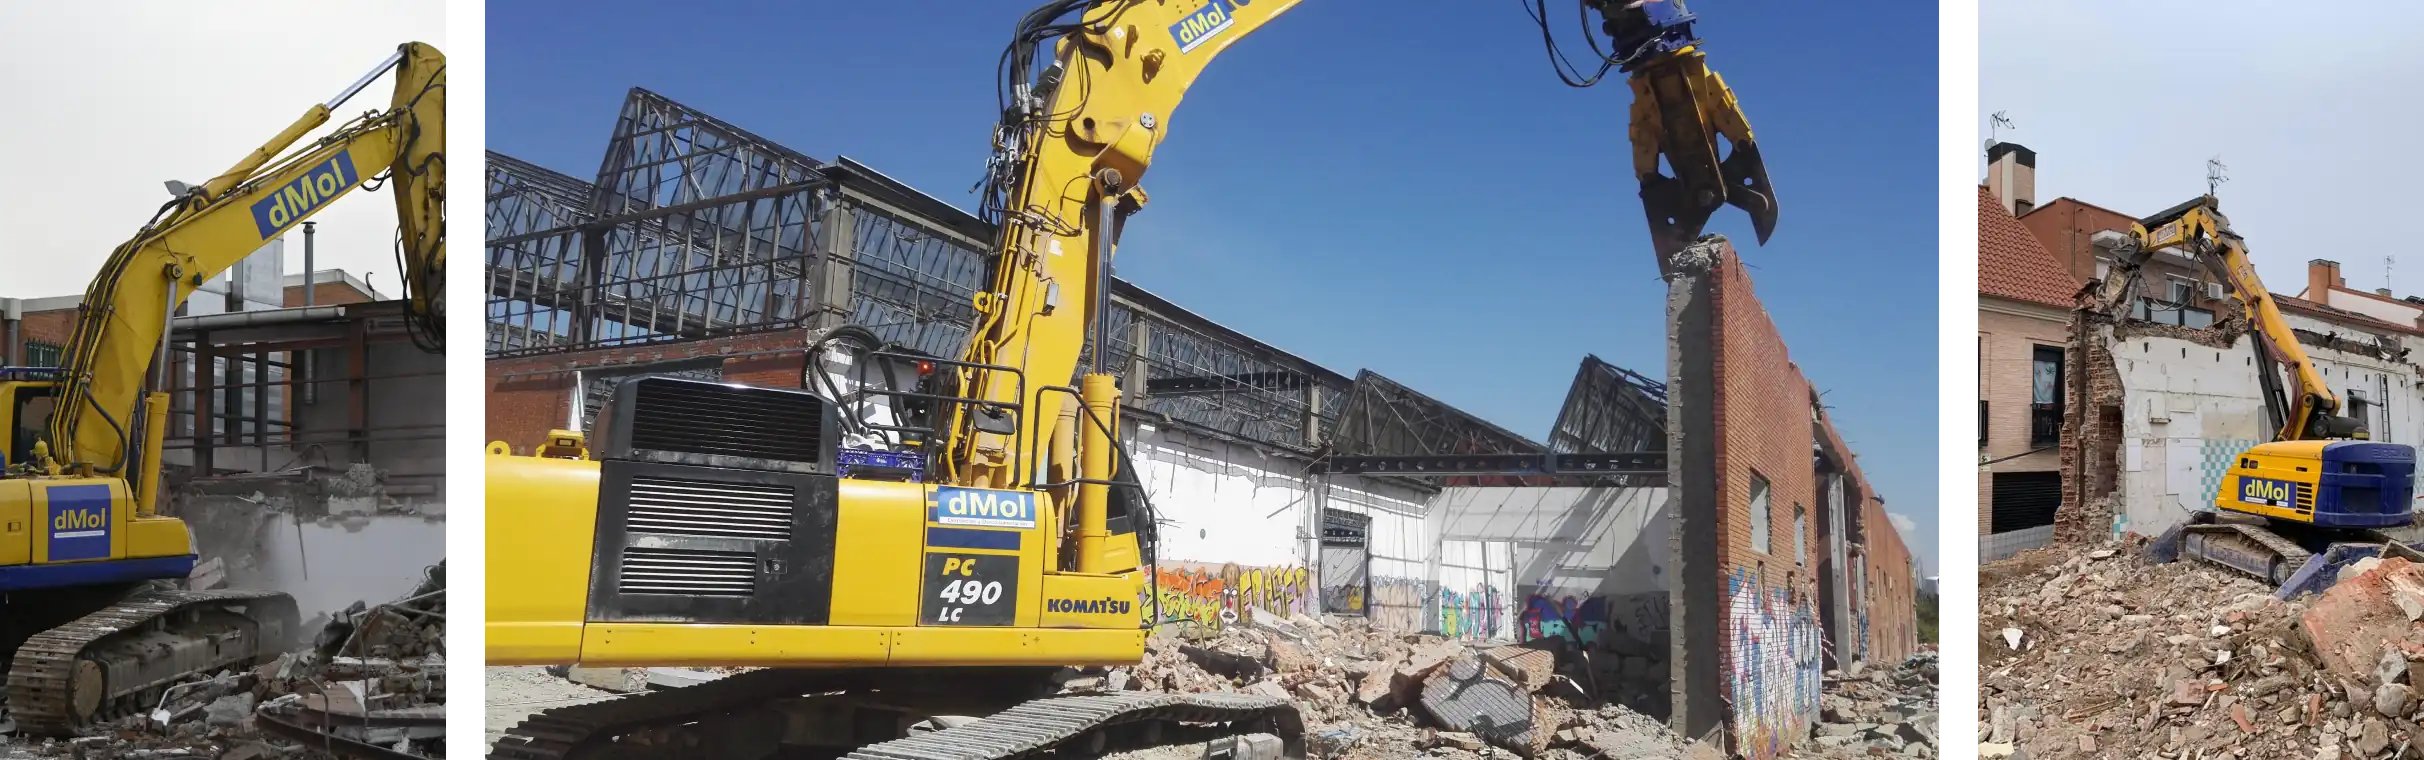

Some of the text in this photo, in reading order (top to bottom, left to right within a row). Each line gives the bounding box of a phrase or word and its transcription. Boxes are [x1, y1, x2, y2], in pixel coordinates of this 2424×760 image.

[1180, 2, 1226, 43] dMol
[269, 158, 347, 228] dMol
[2245, 479, 2289, 501] dMol
[948, 491, 1027, 518] dMol
[54, 507, 106, 530] dMol
[942, 557, 976, 577] PC
[939, 579, 1003, 605] 490
[938, 606, 964, 622] LC
[1047, 597, 1131, 614] KOMATSU
